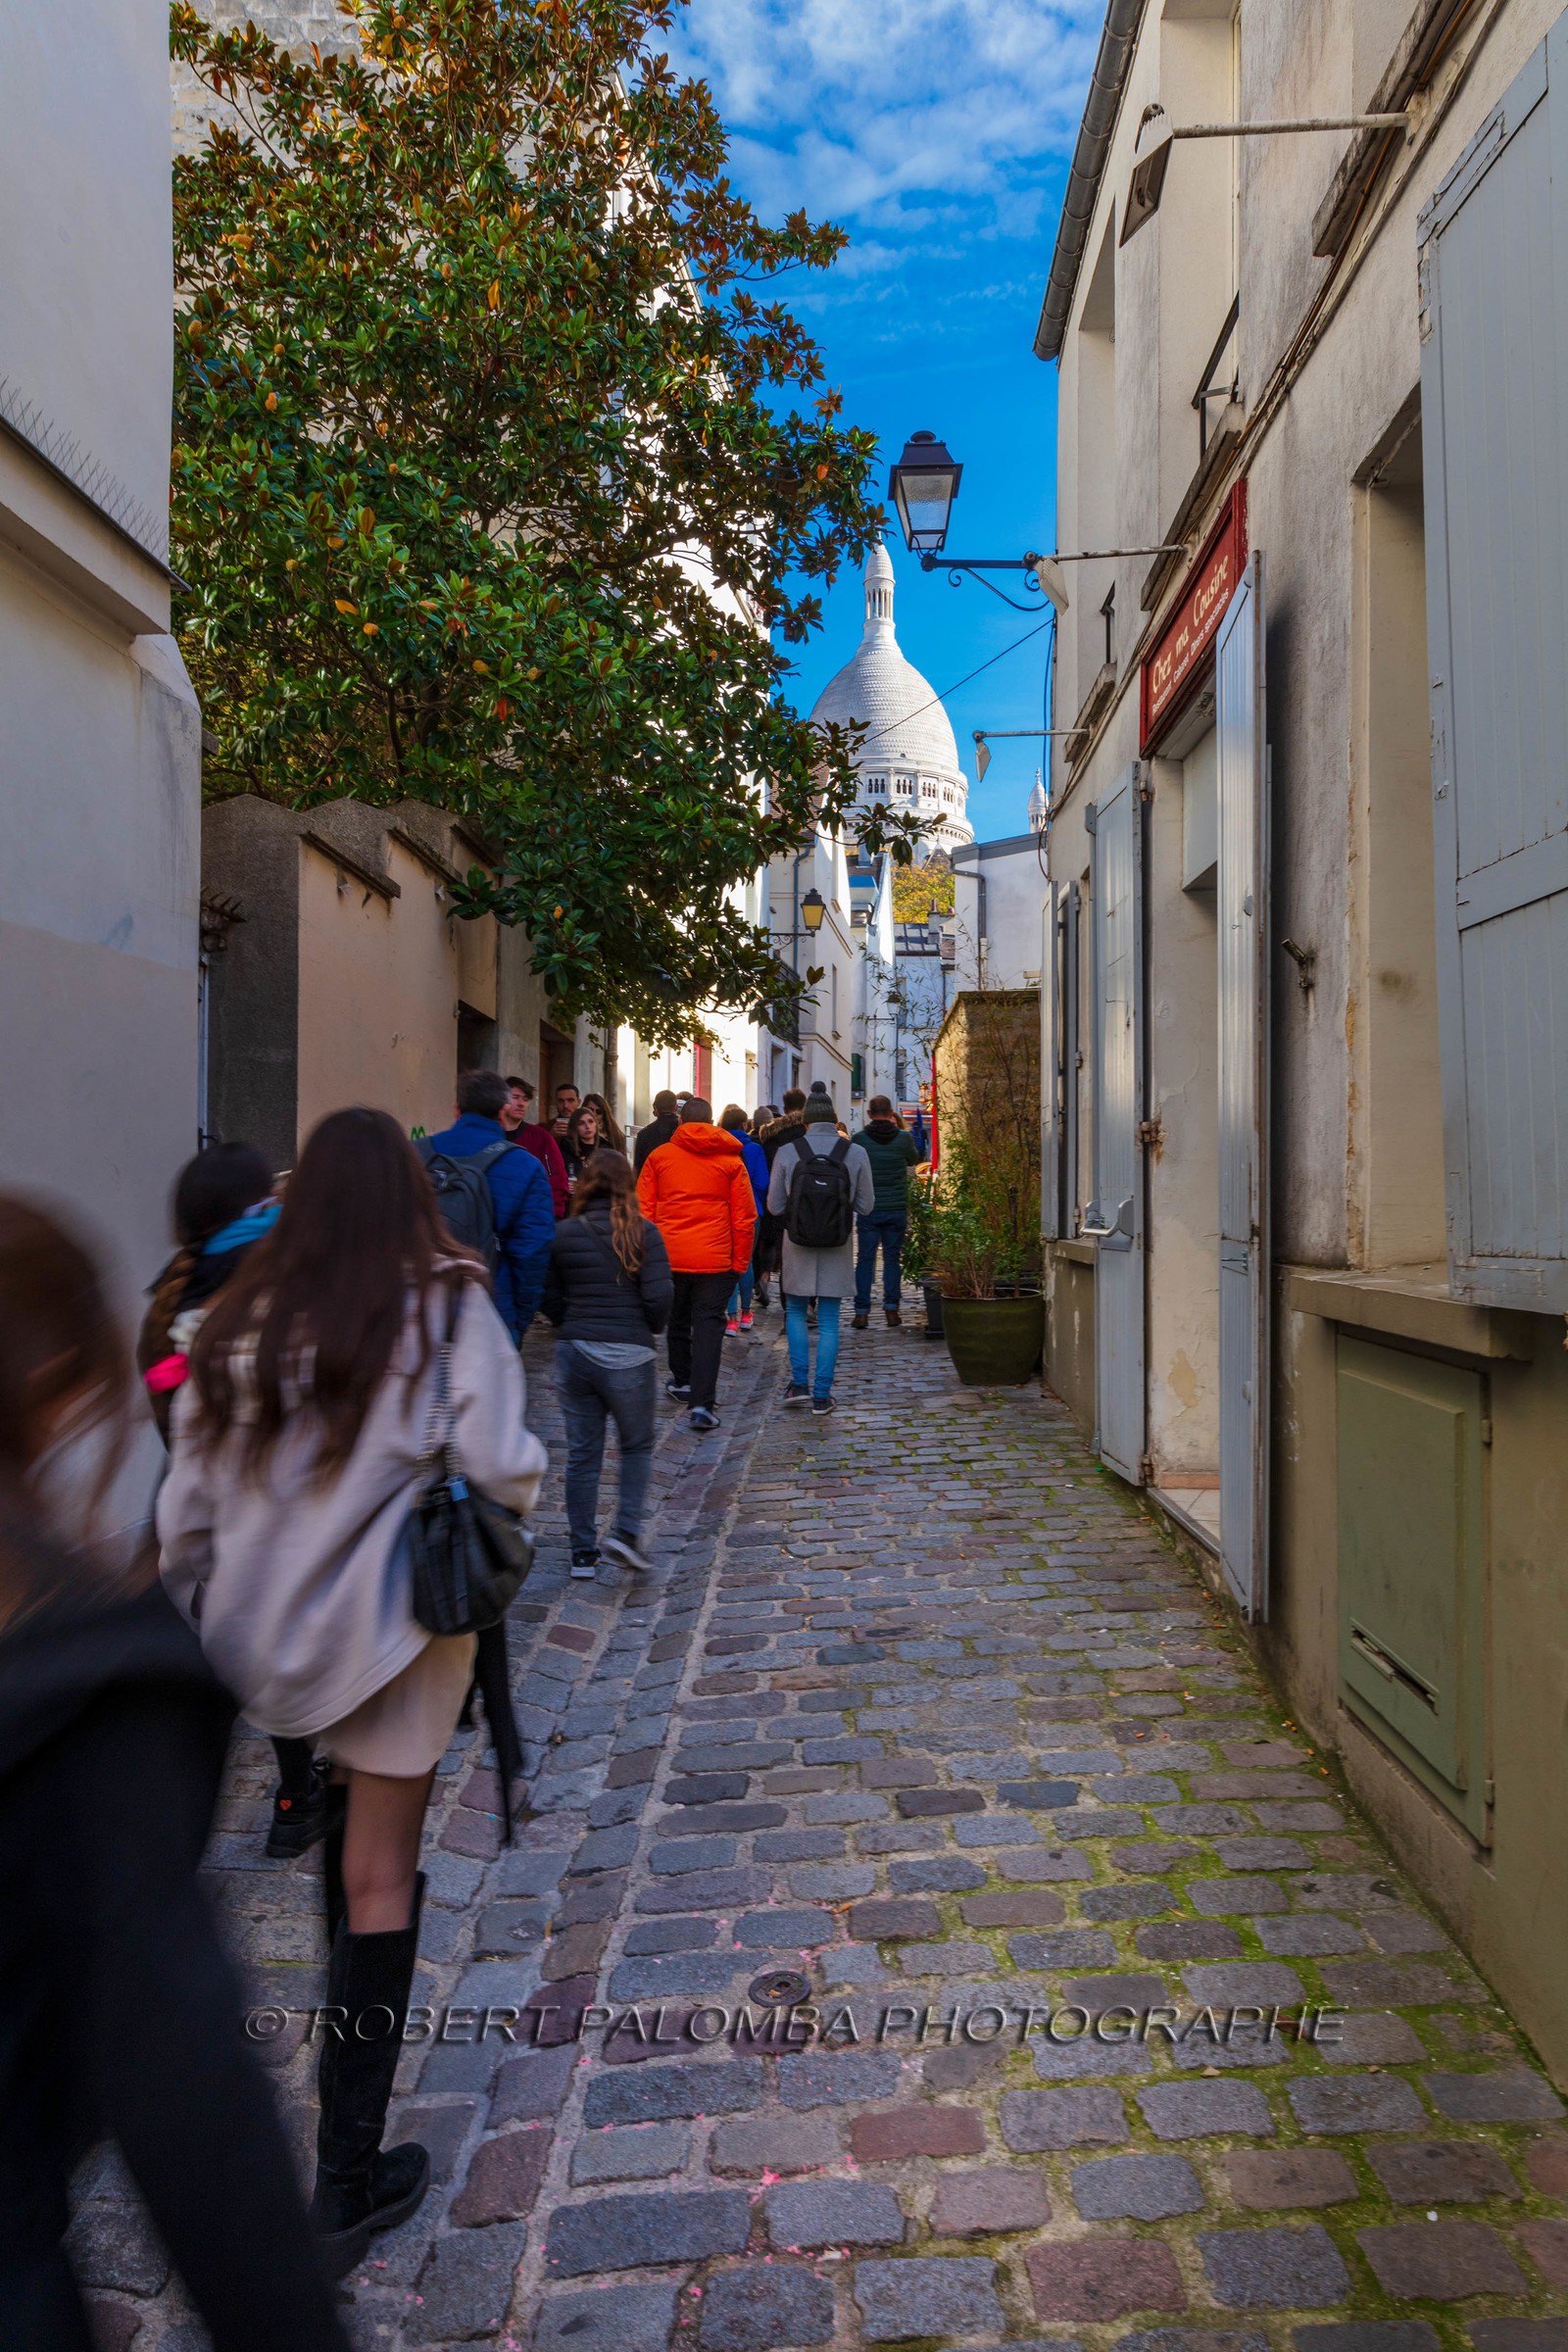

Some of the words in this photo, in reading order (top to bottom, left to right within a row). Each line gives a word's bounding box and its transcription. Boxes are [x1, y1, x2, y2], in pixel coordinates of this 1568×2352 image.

[1152, 652, 1171, 693] Chez
[1176, 625, 1189, 657] ma
[1194, 555, 1228, 626] Cousine
